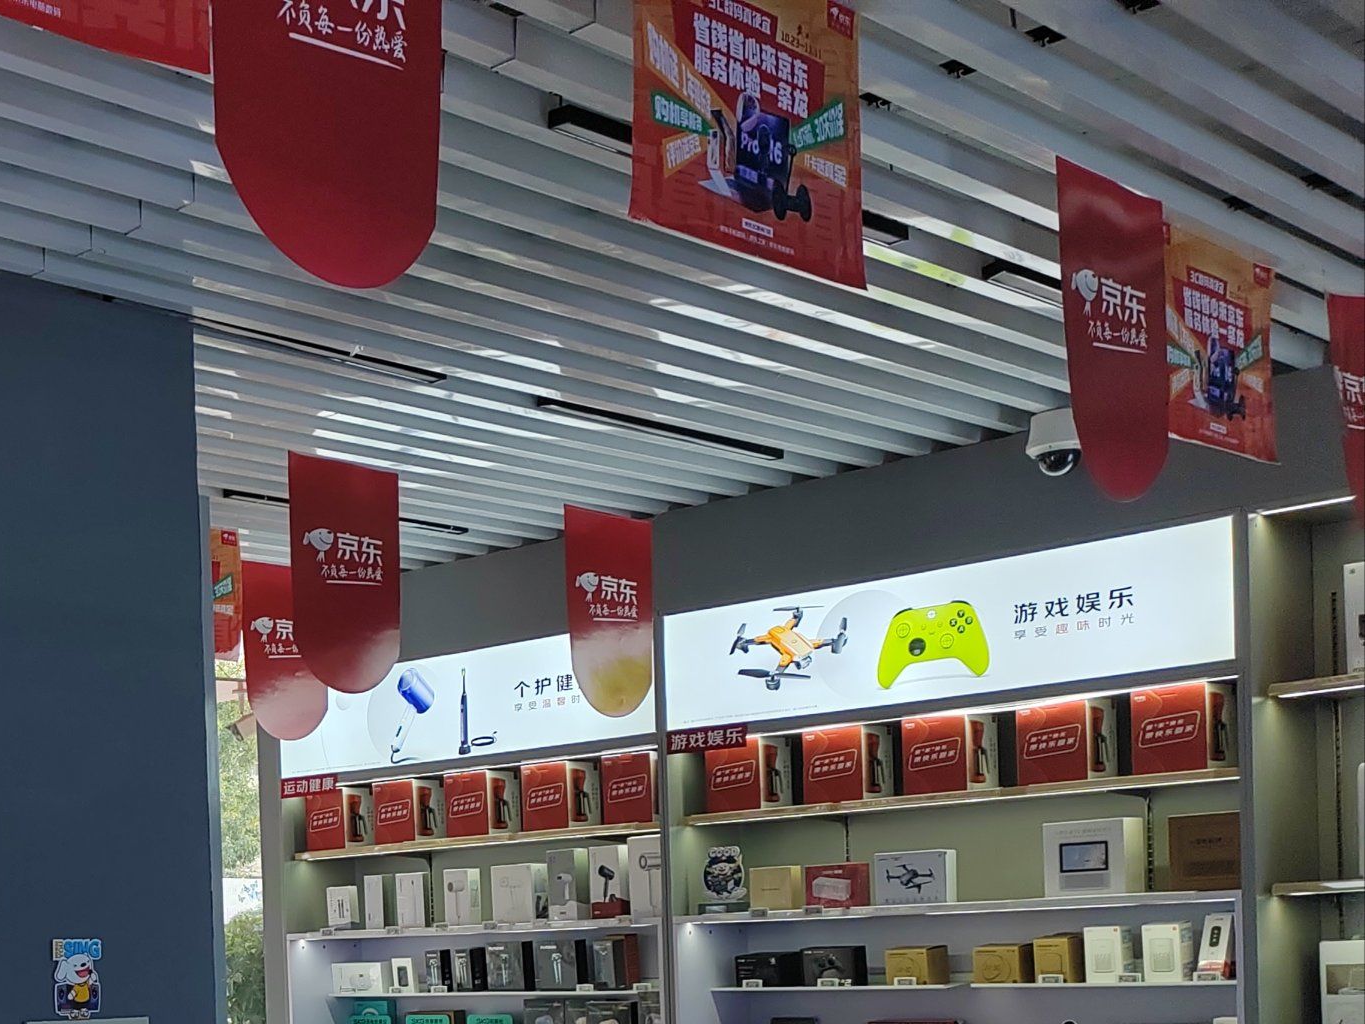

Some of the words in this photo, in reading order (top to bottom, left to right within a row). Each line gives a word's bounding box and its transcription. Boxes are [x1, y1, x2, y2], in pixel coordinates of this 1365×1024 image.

[277, 0, 408, 62] 不负每一份热爱
[693, 12, 809, 89] 省钱省心来京东
[694, 43, 809, 120] 服务体验一条龙
[1100, 277, 1147, 329] 京东
[336, 532, 383, 567] 京东
[600, 575, 638, 605] 京东
[1013, 586, 1134, 624] 游戏娱乐
[275, 619, 294, 641] 京
[1013, 613, 1134, 641] 享受趣味时光
[513, 674, 574, 698] 个护健
[513, 694, 581, 712] 享受温馨时
[671, 727, 744, 751] 游戏娱乐
[283, 776, 335, 796] 运动健康
[708, 846, 740, 859] GOOD
[63, 939, 102, 960] SING
